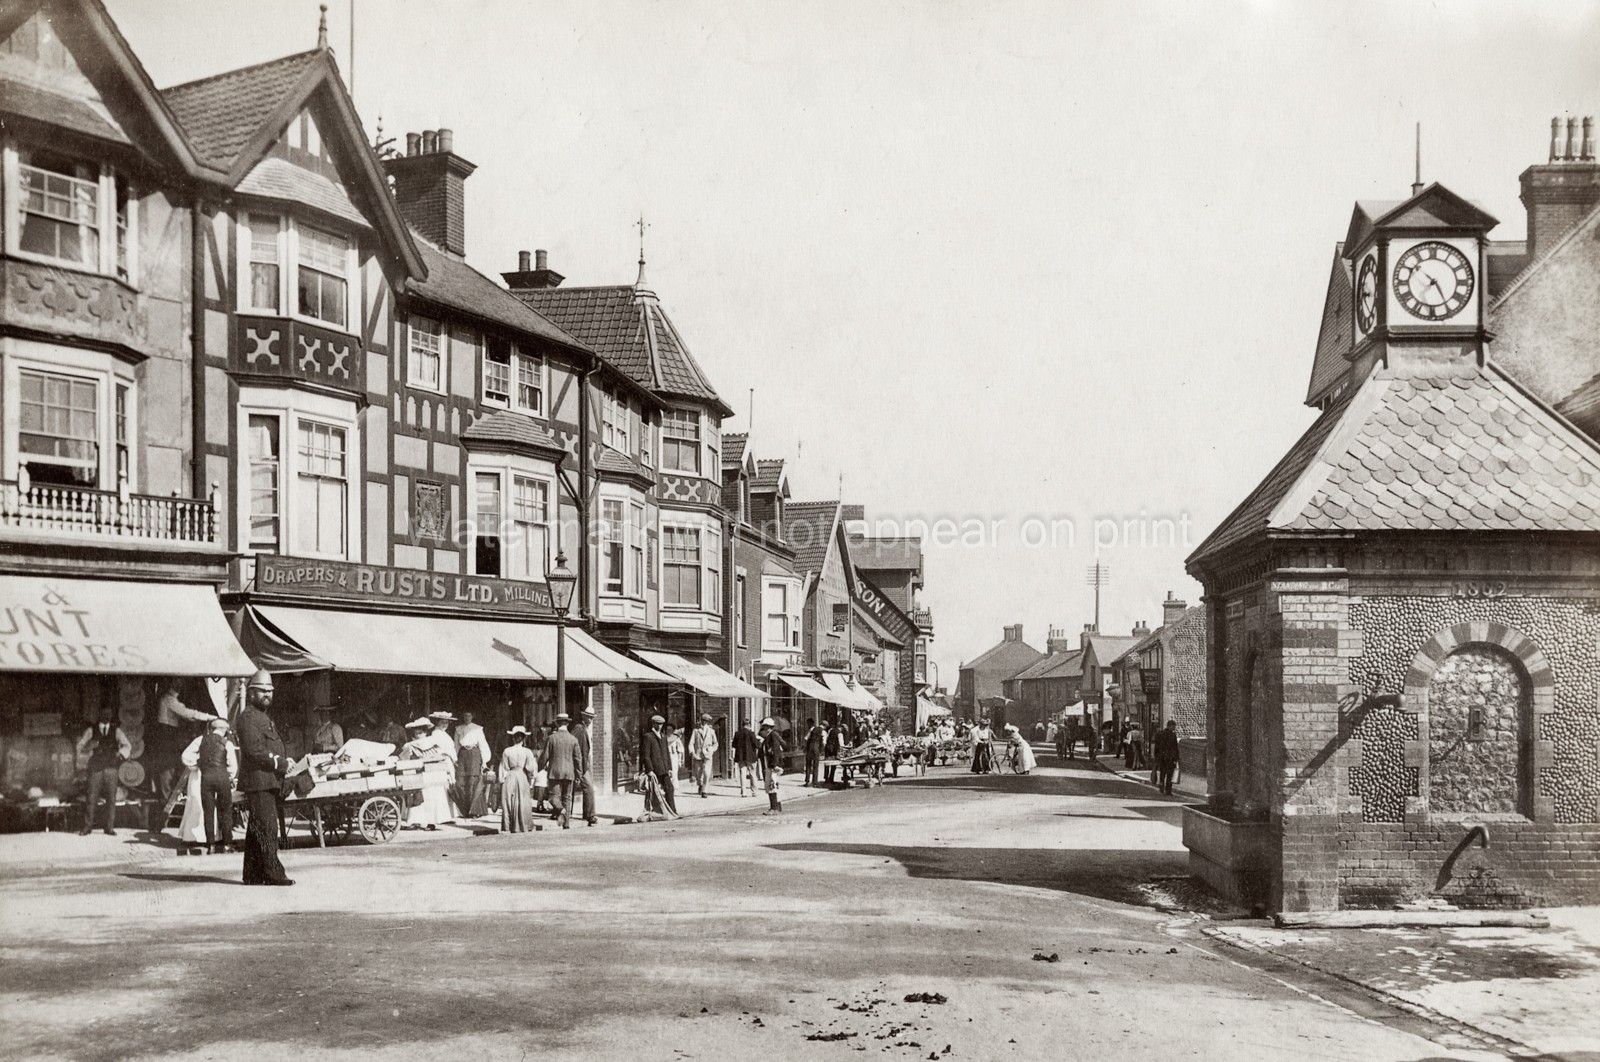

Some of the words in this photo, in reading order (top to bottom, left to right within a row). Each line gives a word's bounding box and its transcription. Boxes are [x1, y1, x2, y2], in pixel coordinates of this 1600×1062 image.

[42, 584, 71, 606] &
[264, 566, 334, 584] DRAPERS
[338, 572, 347, 586] &
[357, 569, 446, 599] RUSTS
[454, 579, 498, 603] LTD.
